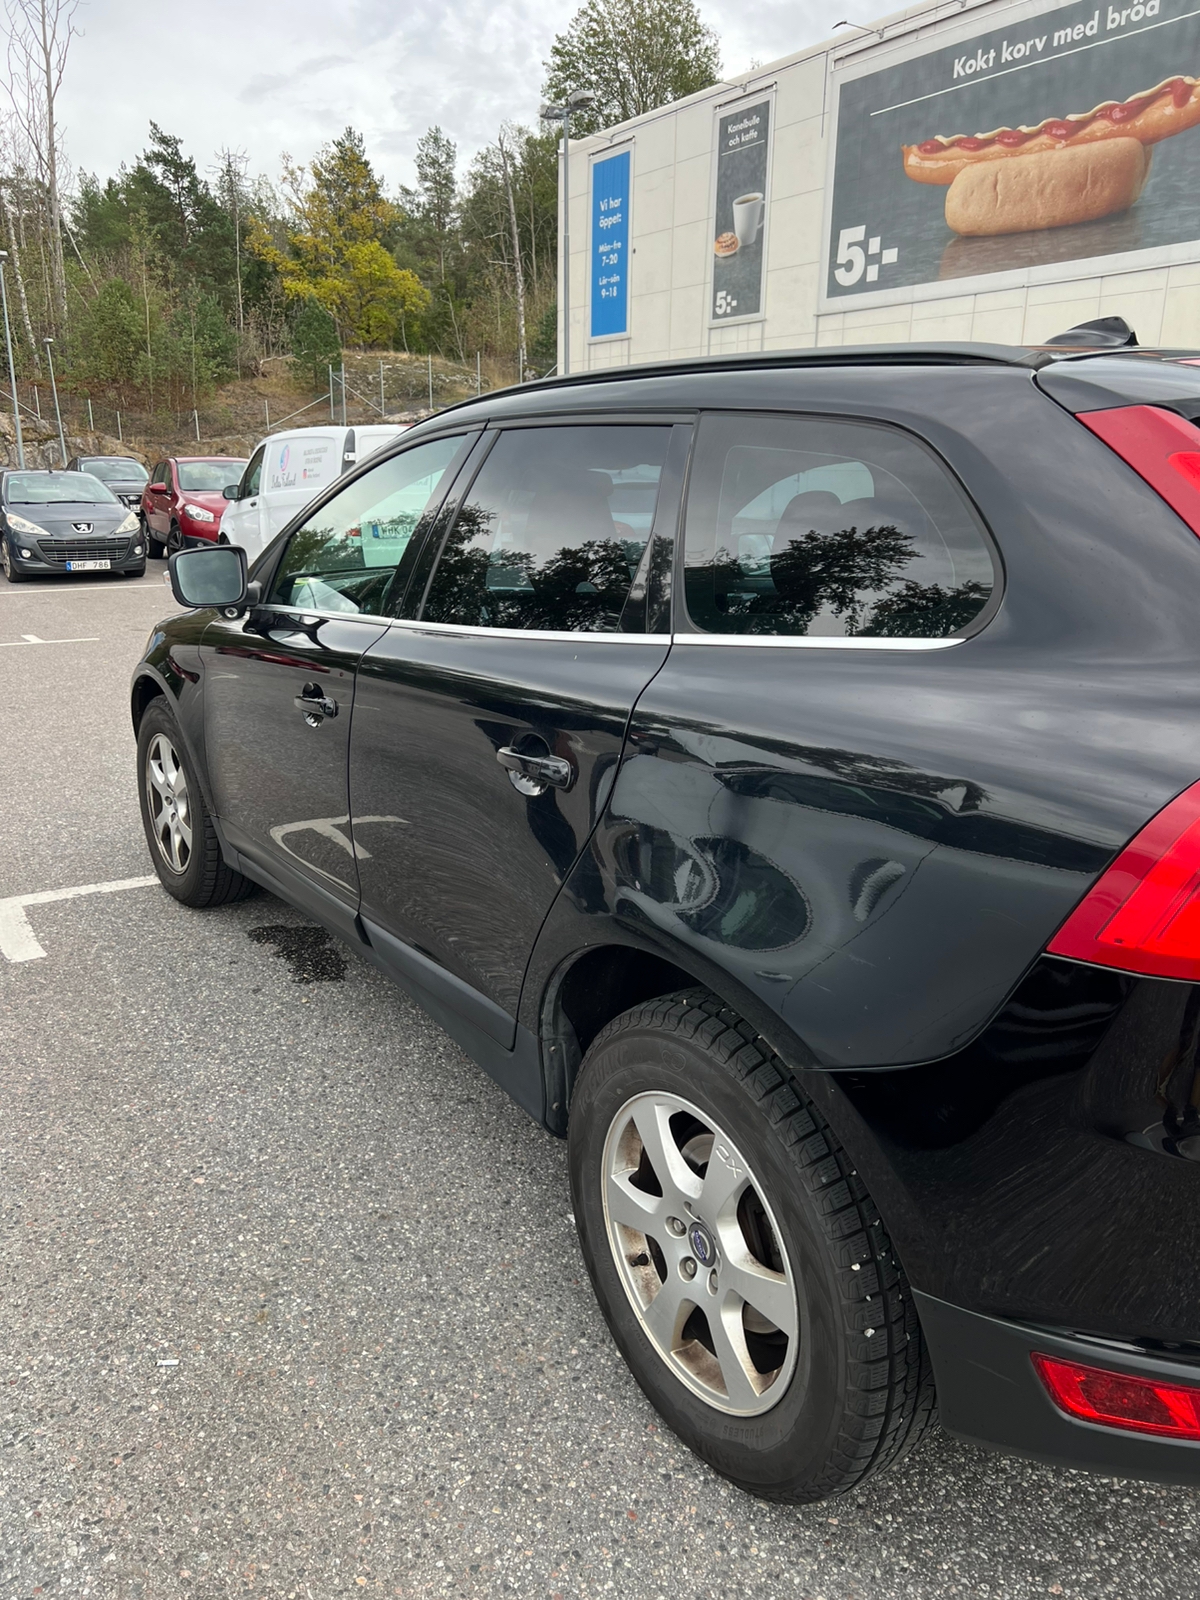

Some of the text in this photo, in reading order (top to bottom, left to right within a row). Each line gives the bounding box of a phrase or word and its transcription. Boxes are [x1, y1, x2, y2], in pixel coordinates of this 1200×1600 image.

[953, 0, 1160, 79] Kokt korv med bröd
[727, 115, 760, 134] Kanelbulle
[729, 129, 758, 146] och kaffe
[600, 196, 622, 211] Vi har
[599, 213, 622, 229] öppet:
[602, 253, 618, 267] 7-20
[834, 225, 898, 286] 5:-
[601, 286, 617, 299] 9-18
[715, 291, 737, 314] 5:-
[72, 561, 109, 570] DHF 786
